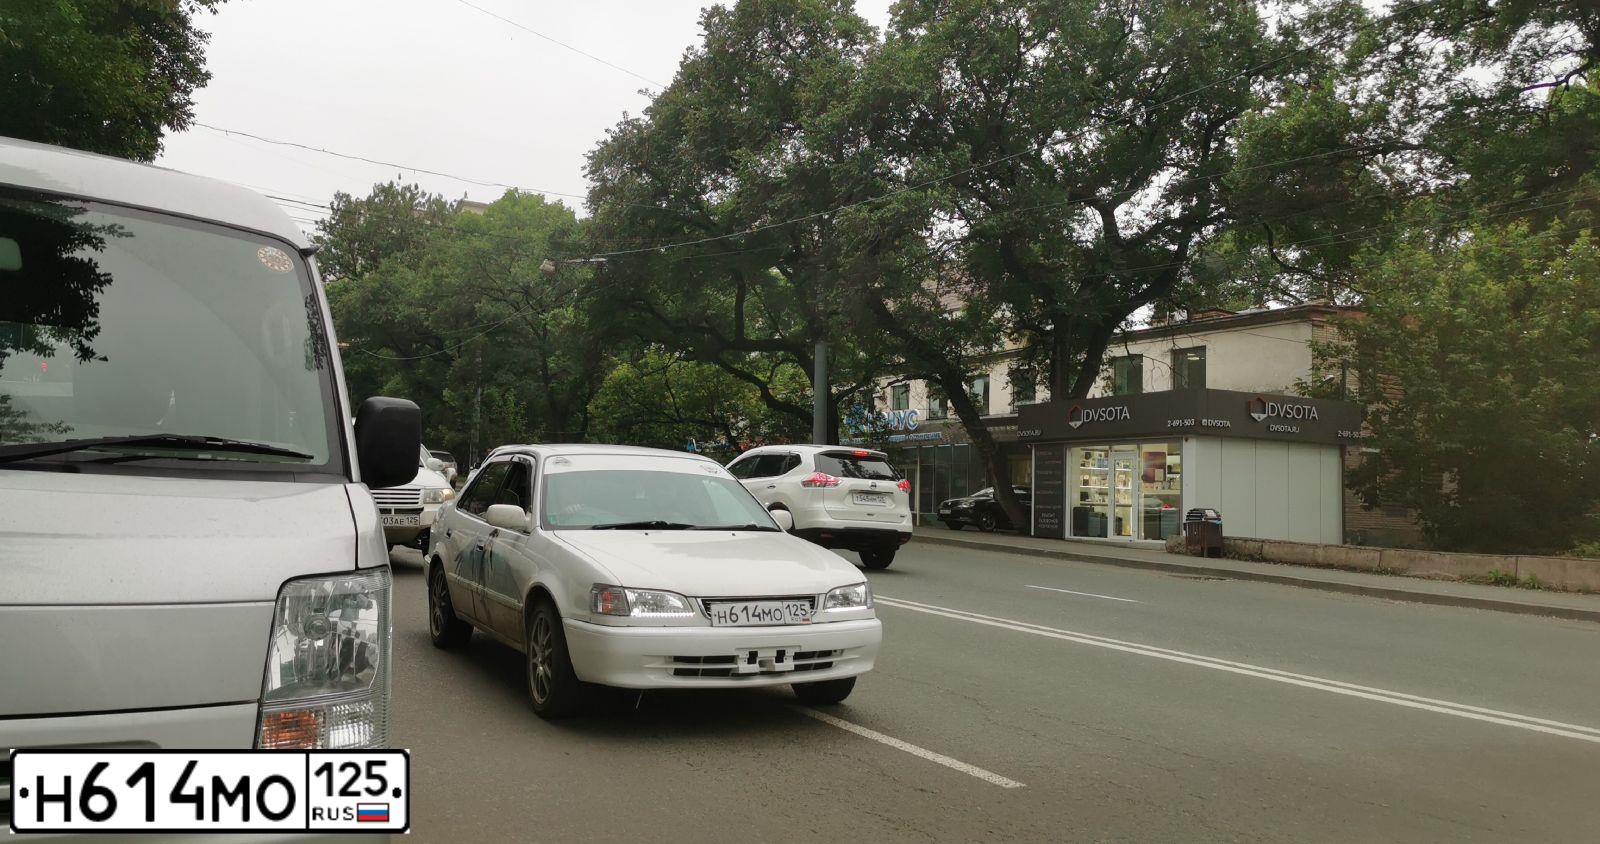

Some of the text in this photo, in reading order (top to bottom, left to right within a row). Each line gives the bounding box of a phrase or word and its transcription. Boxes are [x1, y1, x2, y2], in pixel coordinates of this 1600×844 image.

[1083, 405, 1130, 422] DVSOTA
[1269, 402, 1319, 420] DVSOTA
[1167, 418, 1231, 427] 2-691-503 DVSOTA
[380, 516, 404, 525] 03АЕ
[717, 603, 807, 624] Н614МО 125
